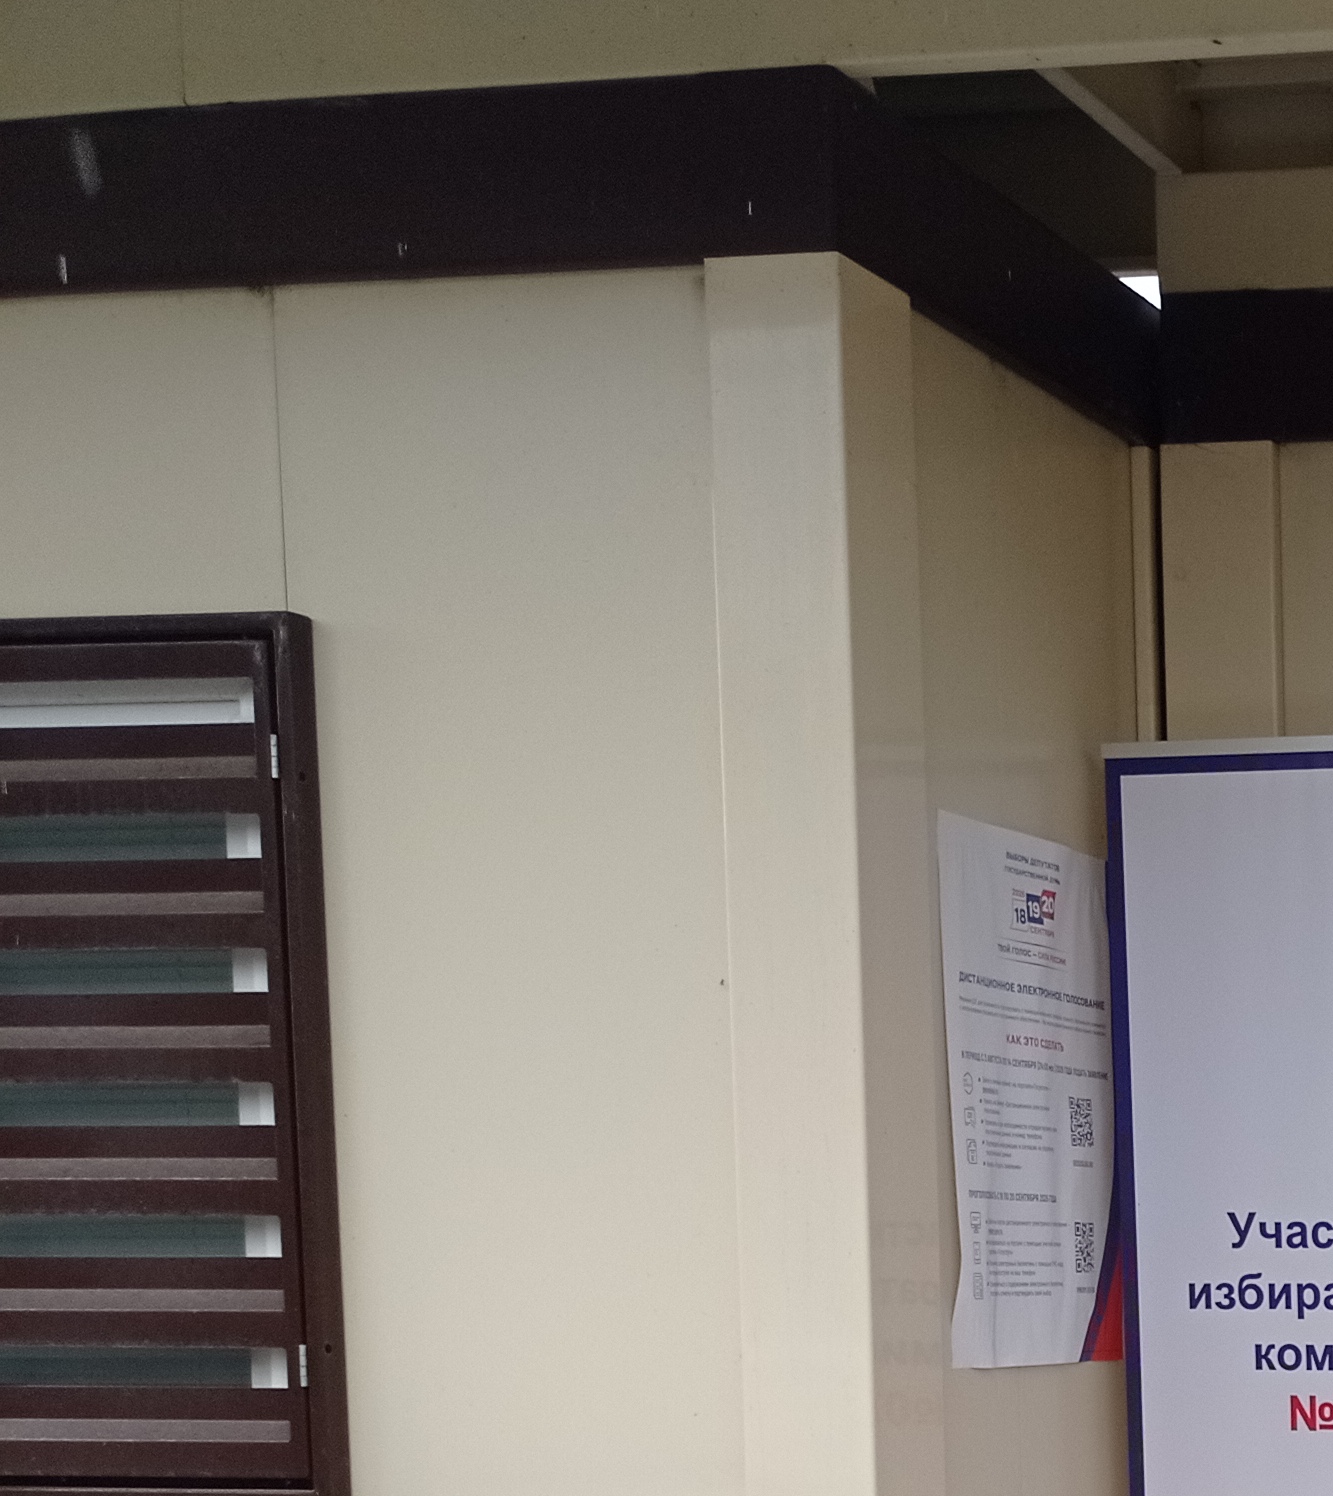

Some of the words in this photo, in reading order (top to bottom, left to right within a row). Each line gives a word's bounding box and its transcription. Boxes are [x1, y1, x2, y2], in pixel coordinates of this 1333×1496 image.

[1027, 901, 1041, 919] 19
[1041, 896, 1054, 914] 20
[1014, 907, 1027, 925] 18
[1016, 983, 1063, 1001] ЭЛЕКТРОННОЕ
[1006, 1034, 1022, 1046] КАК
[1023, 1036, 1039, 1048] ЭТО
